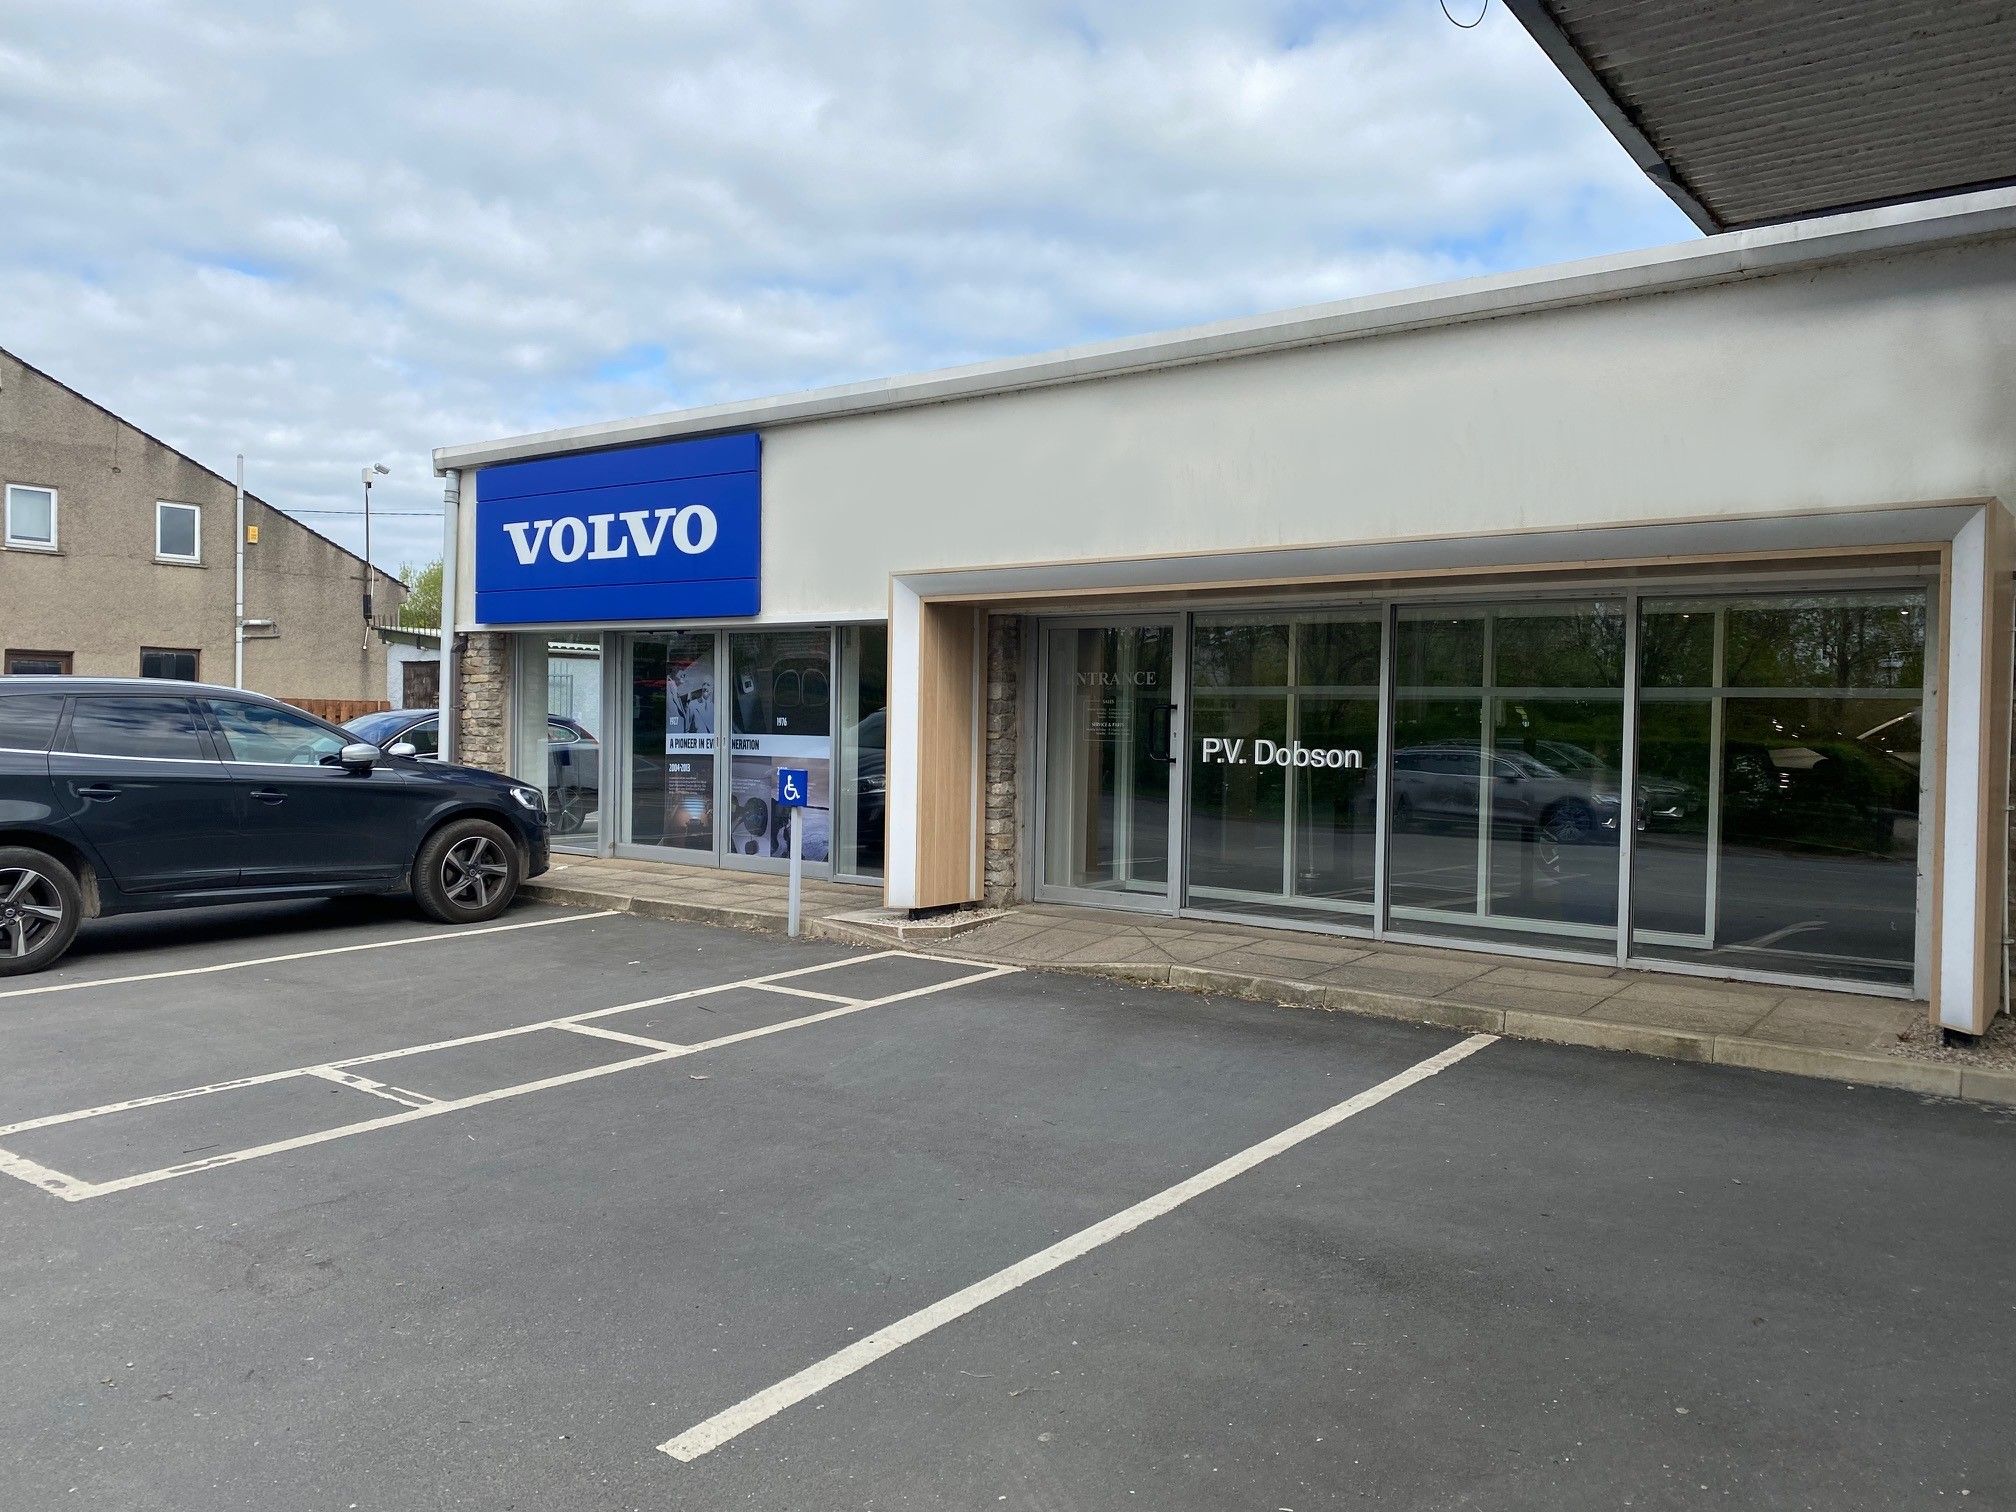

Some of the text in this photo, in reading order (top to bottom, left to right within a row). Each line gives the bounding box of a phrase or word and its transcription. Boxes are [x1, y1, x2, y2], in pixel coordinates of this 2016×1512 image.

[503, 504, 718, 565] VOLVO
[674, 738, 697, 749] PIONEER
[698, 739, 705, 749] IN
[731, 739, 760, 750] NERATION
[1254, 739, 1362, 769] Dobson
